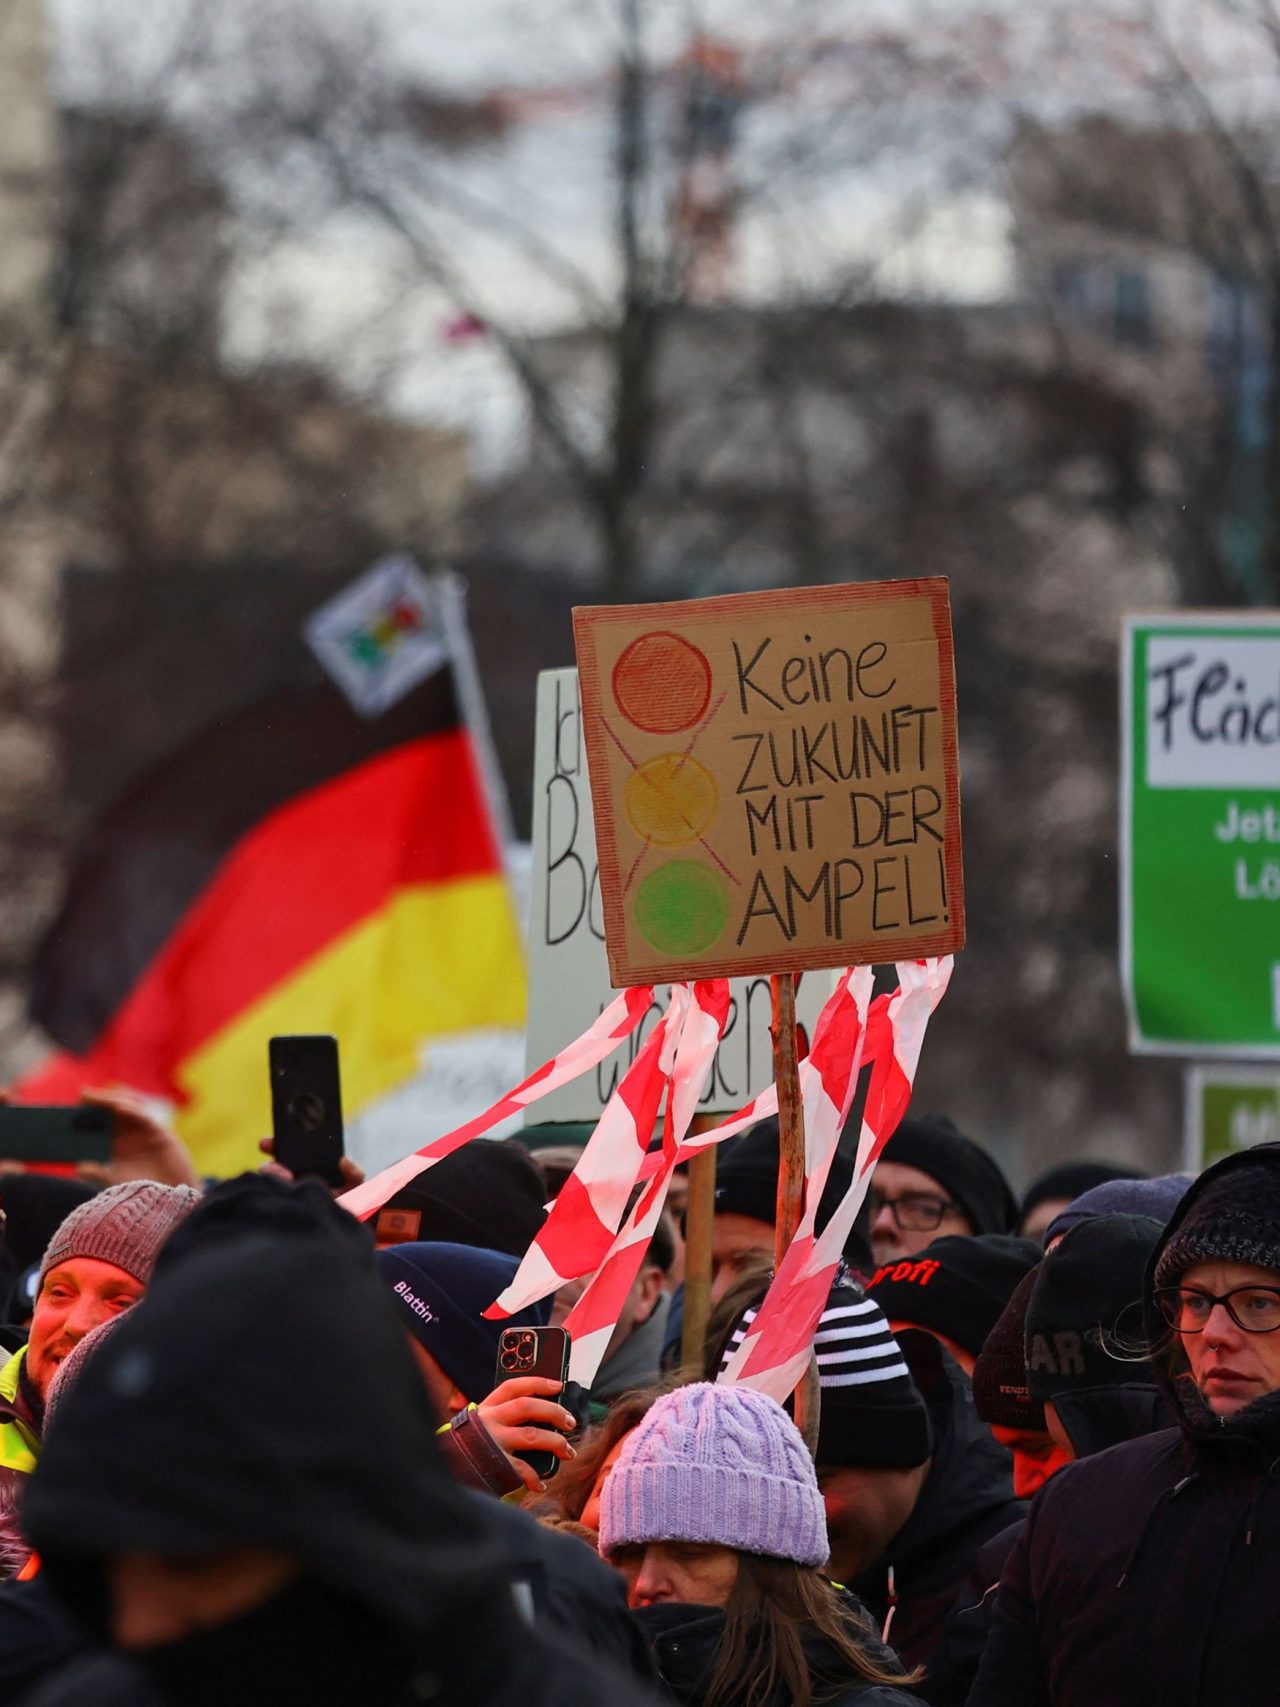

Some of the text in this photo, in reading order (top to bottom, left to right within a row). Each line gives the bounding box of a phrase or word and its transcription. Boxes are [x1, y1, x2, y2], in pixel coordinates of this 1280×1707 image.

[731, 634, 896, 715] Keine
[1151, 652, 1280, 754] Fläc
[731, 704, 938, 794] ZUKUNFT
[745, 785, 944, 856] MIT DER
[736, 848, 949, 946] AMPEL!
[393, 1281, 434, 1324] Blattin
